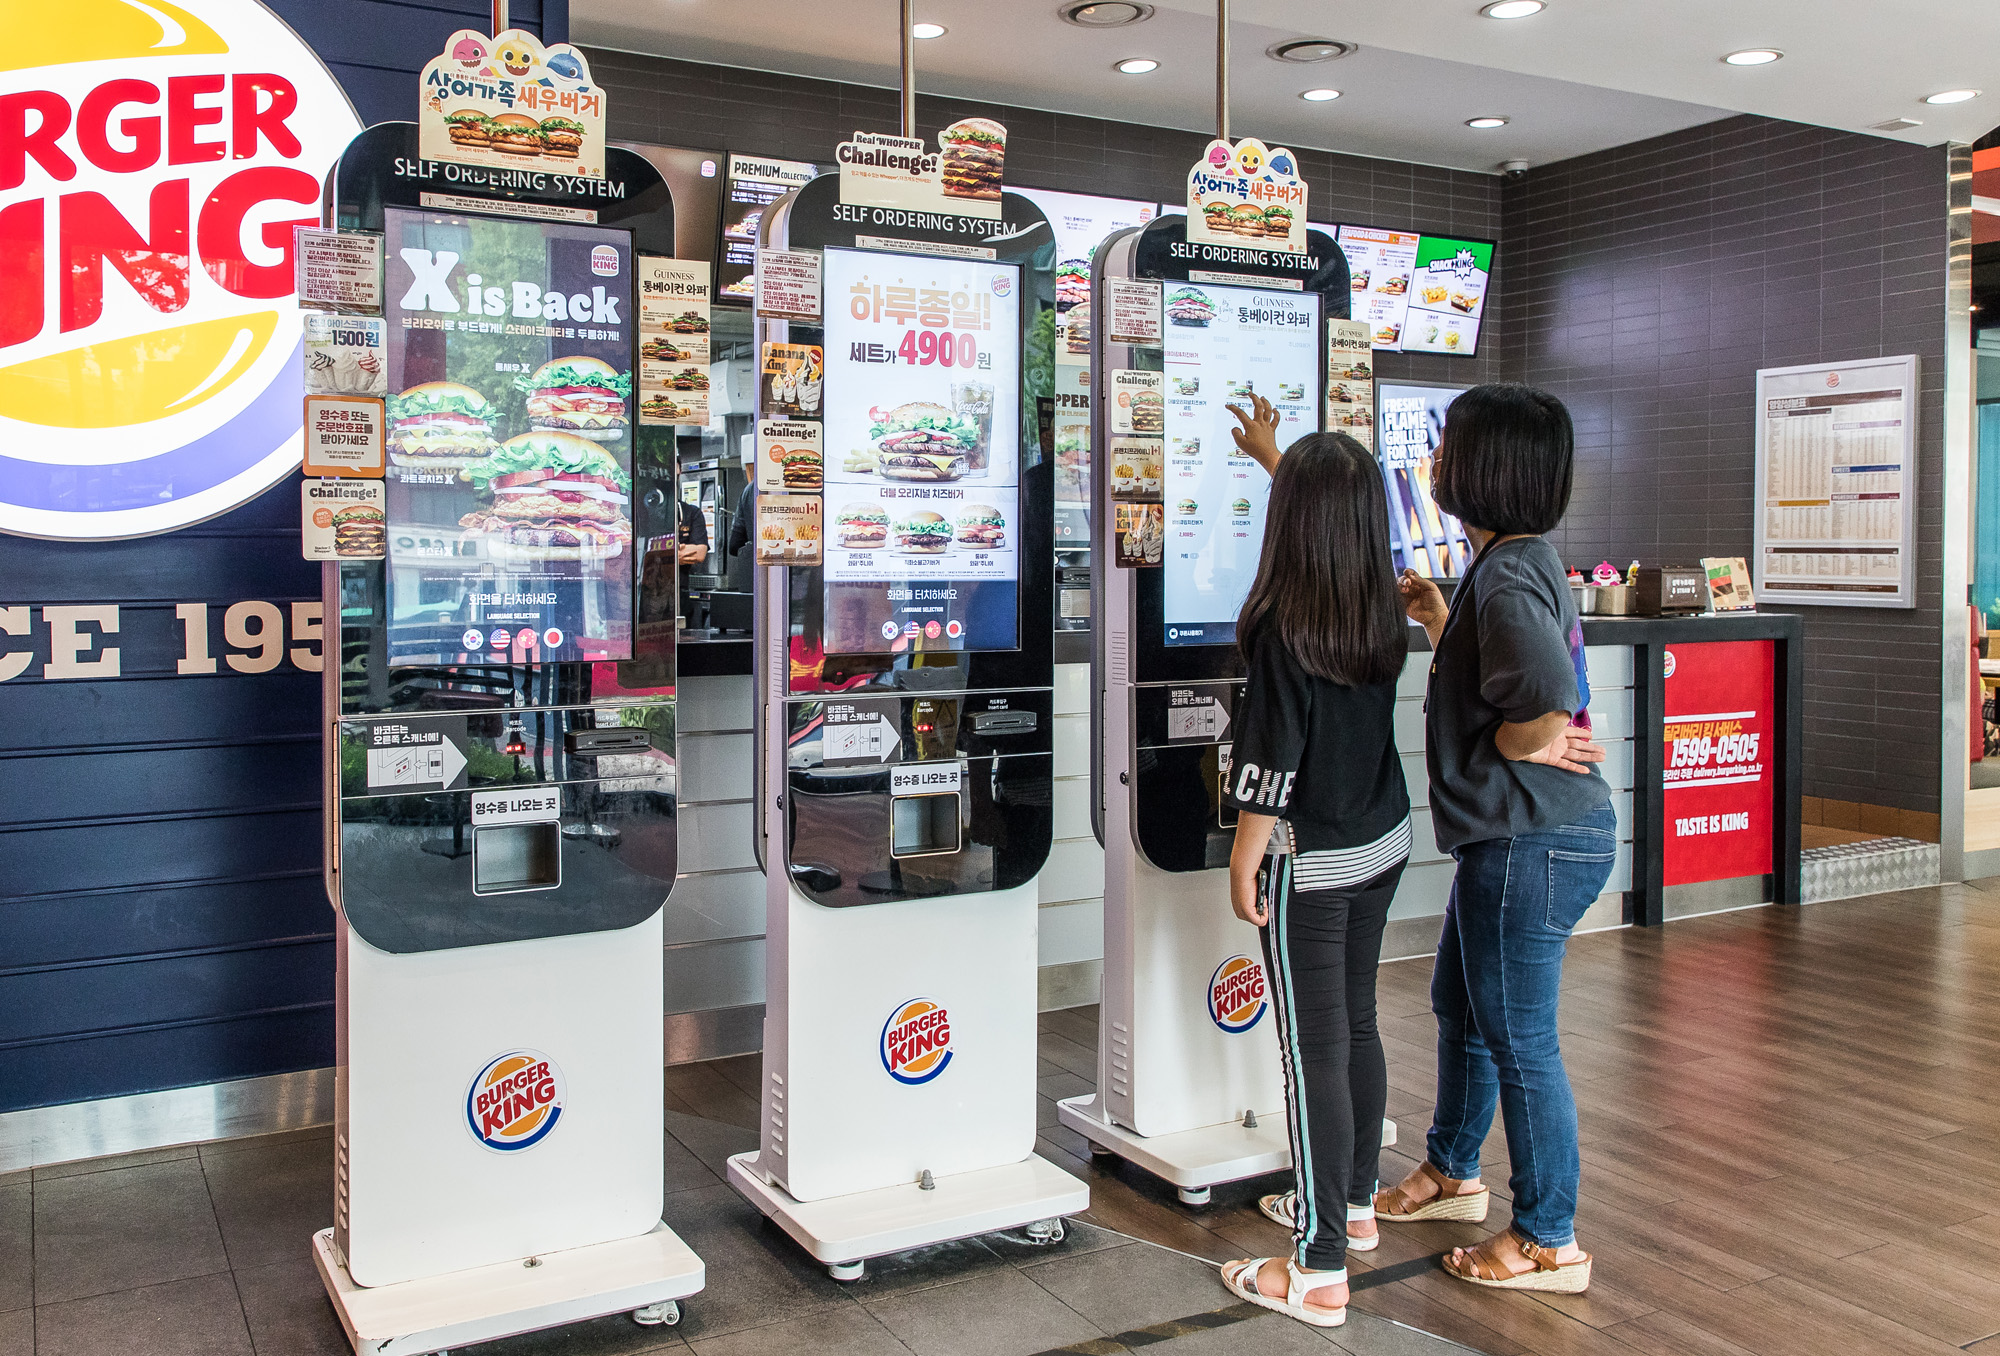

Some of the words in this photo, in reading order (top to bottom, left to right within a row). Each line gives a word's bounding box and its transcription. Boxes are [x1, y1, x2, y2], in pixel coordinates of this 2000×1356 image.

[427, 68, 516, 109] 상어가족
[517, 86, 600, 118] 새우버거
[0, 72, 302, 190] RGER
[856, 134, 875, 146] Real
[839, 145, 938, 176] Challenge!
[395, 157, 439, 180] SELF
[445, 164, 546, 190] ORDERING
[553, 175, 625, 199] SYSTEM
[734, 161, 781, 179] PREMIUM
[780, 171, 812, 182] COLLECTION
[1192, 170, 1249, 200] 상어가족
[1250, 182, 1303, 206] 새우버거
[832, 204, 868, 223] SELF
[873, 208, 954, 232] ORDERING
[958, 217, 1017, 237] SYSTEM
[0, 166, 321, 350] ING
[592, 254, 618, 263] BURGER
[1170, 242, 1199, 258] SELF
[1202, 246, 1268, 266] ORDERING
[1272, 253, 1319, 271] SYSTEM
[1379, 248, 1386, 256] 10
[592, 261, 618, 271] KING
[1429, 259, 1453, 272] SNACK
[1455, 258, 1472, 269] KING
[653, 269, 695, 281] GUINNESS
[400, 247, 461, 313] X
[466, 273, 507, 317] is
[511, 281, 622, 325] Back
[642, 280, 685, 295] 통베이컨
[686, 284, 707, 296] 와퍼
[993, 281, 1011, 292] KING
[849, 275, 991, 331] 하루종일!
[1252, 295, 1295, 309] GUINNESS
[1371, 299, 1378, 307] 12
[327, 318, 367, 330] 아이스크림
[1238, 307, 1285, 326] 통베이컨
[1287, 311, 1310, 327] 와퍼
[401, 316, 455, 331] 브리오쉬로
[458, 320, 503, 335] 부드럽게!
[505, 324, 575, 340] 스테이크패티로
[577, 329, 620, 342] 두툼하게!
[1337, 328, 1363, 338] GUINNESS
[331, 329, 380, 348] 1500원
[1330, 338, 1358, 350] 통베이컨
[1358, 339, 1370, 350] 와퍼
[849, 342, 896, 364] 세트가
[898, 330, 991, 370] 4900원
[1116, 375, 1160, 387] Challenge!
[1384, 397, 1426, 412] FRESHLY
[319, 409, 349, 422] 영수증
[351, 411, 370, 422] 또는
[1384, 412, 1428, 431] FLAME
[316, 421, 374, 434] 주문번호표를
[763, 427, 817, 440] Challenge!
[320, 434, 369, 446] 받아가세요
[1385, 430, 1428, 446] GRILLED
[1386, 444, 1408, 460] FOR
[1409, 443, 1428, 458] YOU
[1387, 459, 1405, 469] SINCE
[399, 473, 455, 485] 콰트로치즈X
[309, 487, 377, 500] Challenge!
[880, 488, 896, 499] 더블
[898, 488, 931, 499] 오리지널
[932, 489, 964, 500] 치즈버거
[805, 502, 818, 515] 1+1
[468, 593, 502, 606] 화면을
[504, 593, 558, 606] 터치하세요
[887, 589, 913, 600] 화면을
[914, 589, 958, 600] 터치하세요
[513, 612, 541, 620] SELECTION
[1171, 689, 1194, 698] 바코드는
[827, 705, 855, 714] 바코드는
[827, 713, 849, 723] 오른쪽
[849, 711, 879, 722] 스캐너에!
[373, 724, 409, 735] 바코드는
[505, 725, 527, 733] Barcode
[1663, 723, 1702, 742] 딜리버리
[1703, 722, 1714, 740] 킹
[1714, 720, 1743, 738] 서비스
[373, 735, 400, 746] 오른쪽
[401, 732, 439, 744] 스캐너에!
[1670, 732, 1760, 768] 1599-0505
[893, 774, 920, 787] 영수증
[921, 773, 948, 785] 나오는
[949, 771, 958, 783] 곳
[1680, 768, 1693, 780] 주문
[1693, 763, 1764, 779] delivery.burgerking.co.kr
[475, 801, 508, 815] 영수증
[510, 800, 544, 813] 나오는
[545, 798, 556, 811] 곳
[1675, 816, 1708, 837] TASTE
[1709, 814, 1720, 834] IS
[1721, 812, 1749, 831] KING
[1213, 964, 1262, 1003] BURGER
[1216, 977, 1264, 1022] KING
[888, 1009, 948, 1047] BURGER
[890, 1023, 951, 1073] KING
[476, 1061, 550, 1115] BURGER
[482, 1078, 556, 1139] KING
